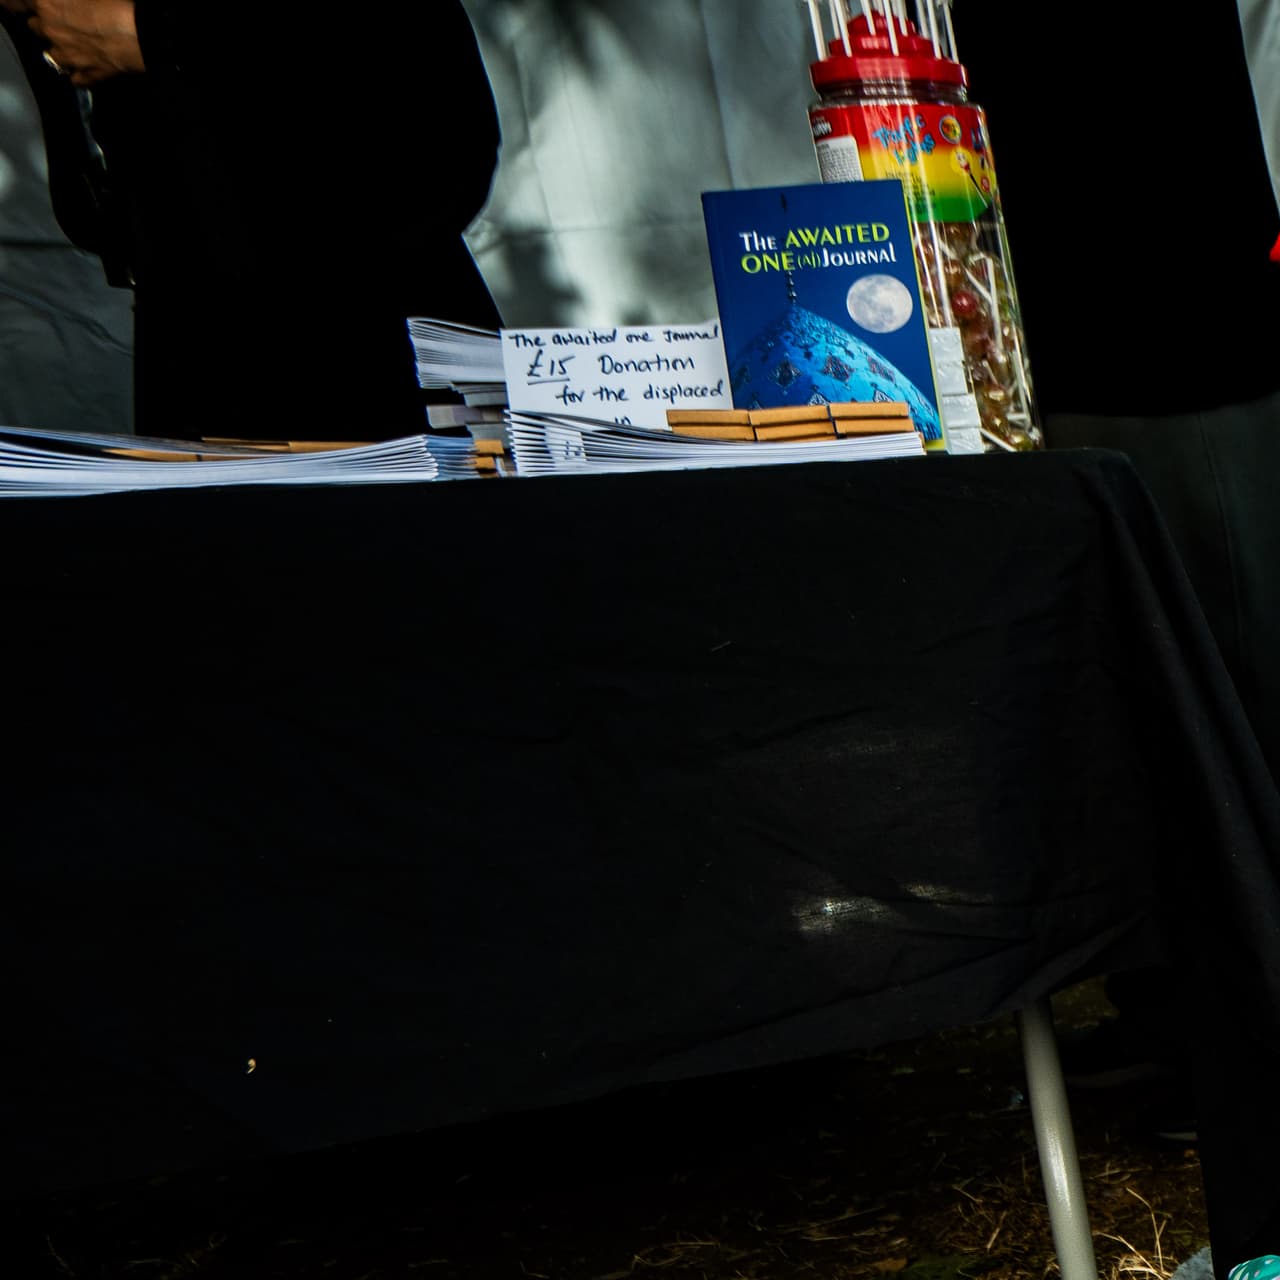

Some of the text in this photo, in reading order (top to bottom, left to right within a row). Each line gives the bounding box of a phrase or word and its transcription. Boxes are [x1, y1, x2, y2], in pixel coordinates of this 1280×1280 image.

[785, 222, 890, 249] AWAITED
[741, 252, 796, 274] ONE
[509, 331, 547, 348] The
[626, 331, 655, 344] one
[527, 349, 696, 378] £15 Donation
[555, 379, 724, 406] for the displaced
